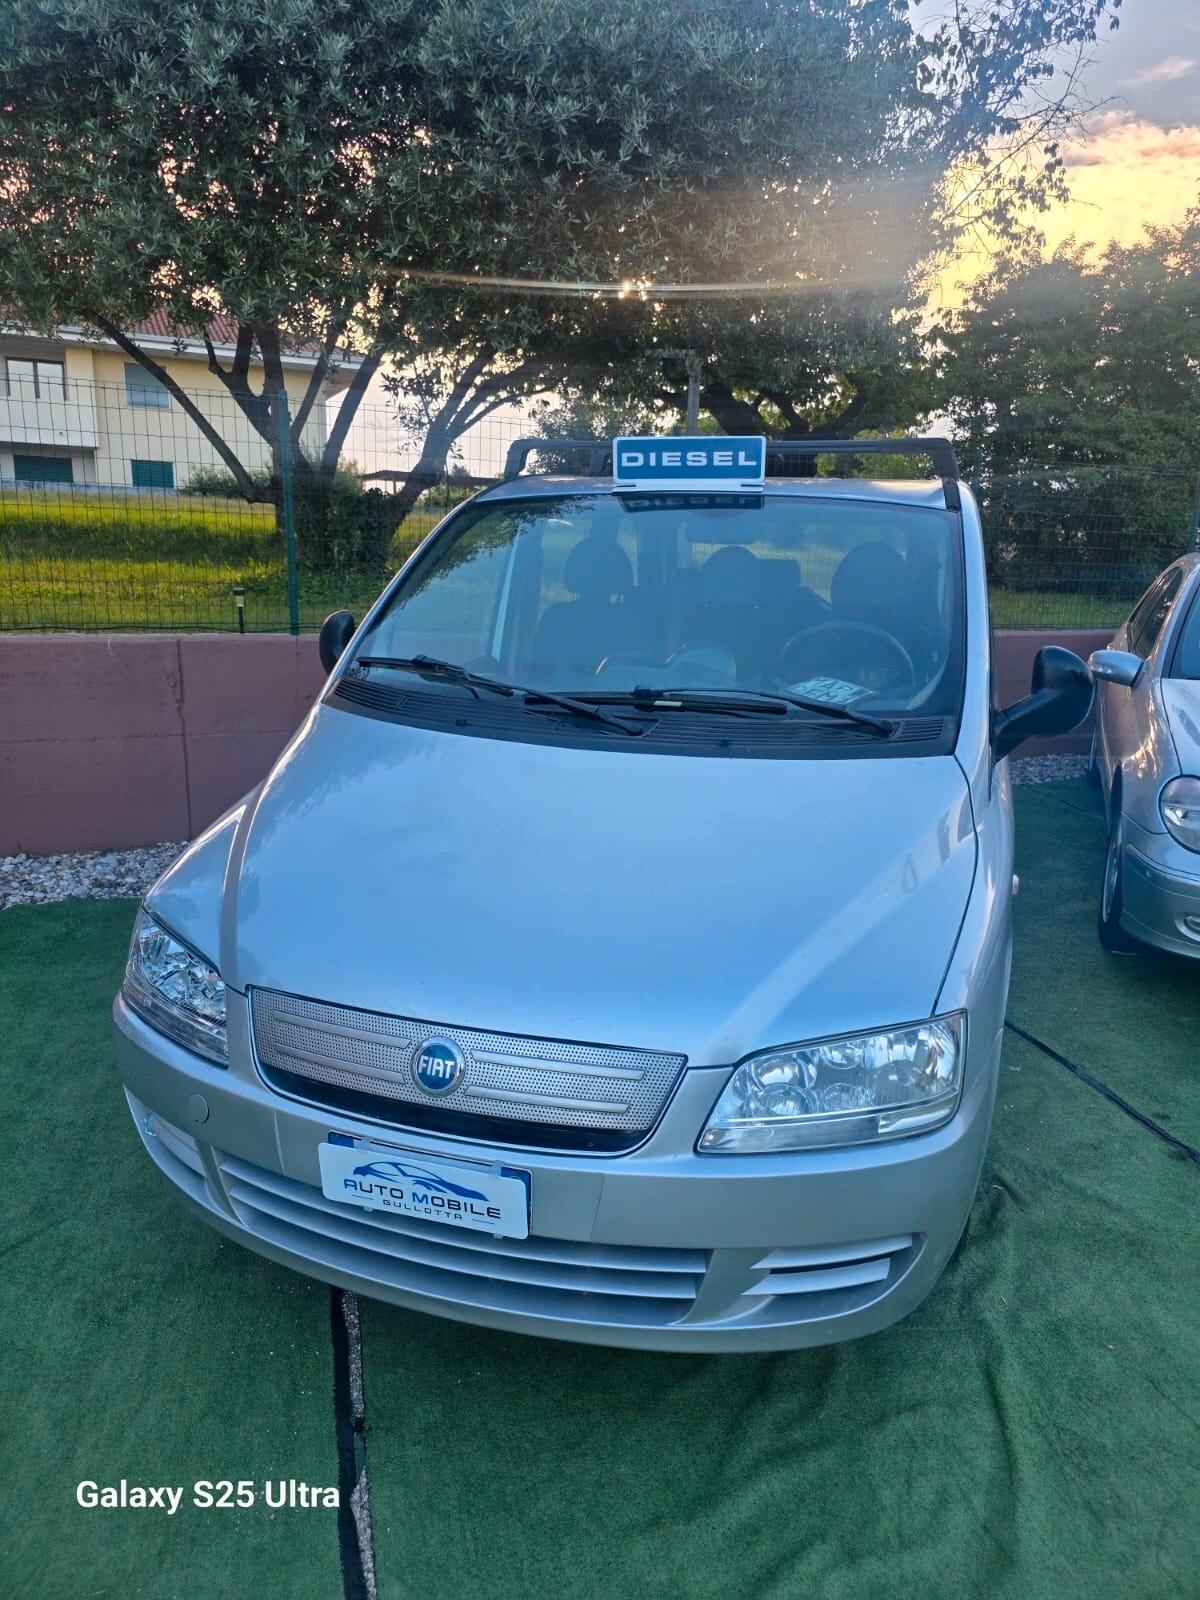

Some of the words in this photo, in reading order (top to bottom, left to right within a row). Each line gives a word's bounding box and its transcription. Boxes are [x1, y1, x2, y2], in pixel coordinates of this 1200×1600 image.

[621, 451, 757, 467] DIESEL
[418, 1054, 455, 1079] FIAT
[344, 1178, 404, 1200] AUTO
[412, 1191, 502, 1219] MOBILE
[383, 1199, 463, 1221] GULLOTTA
